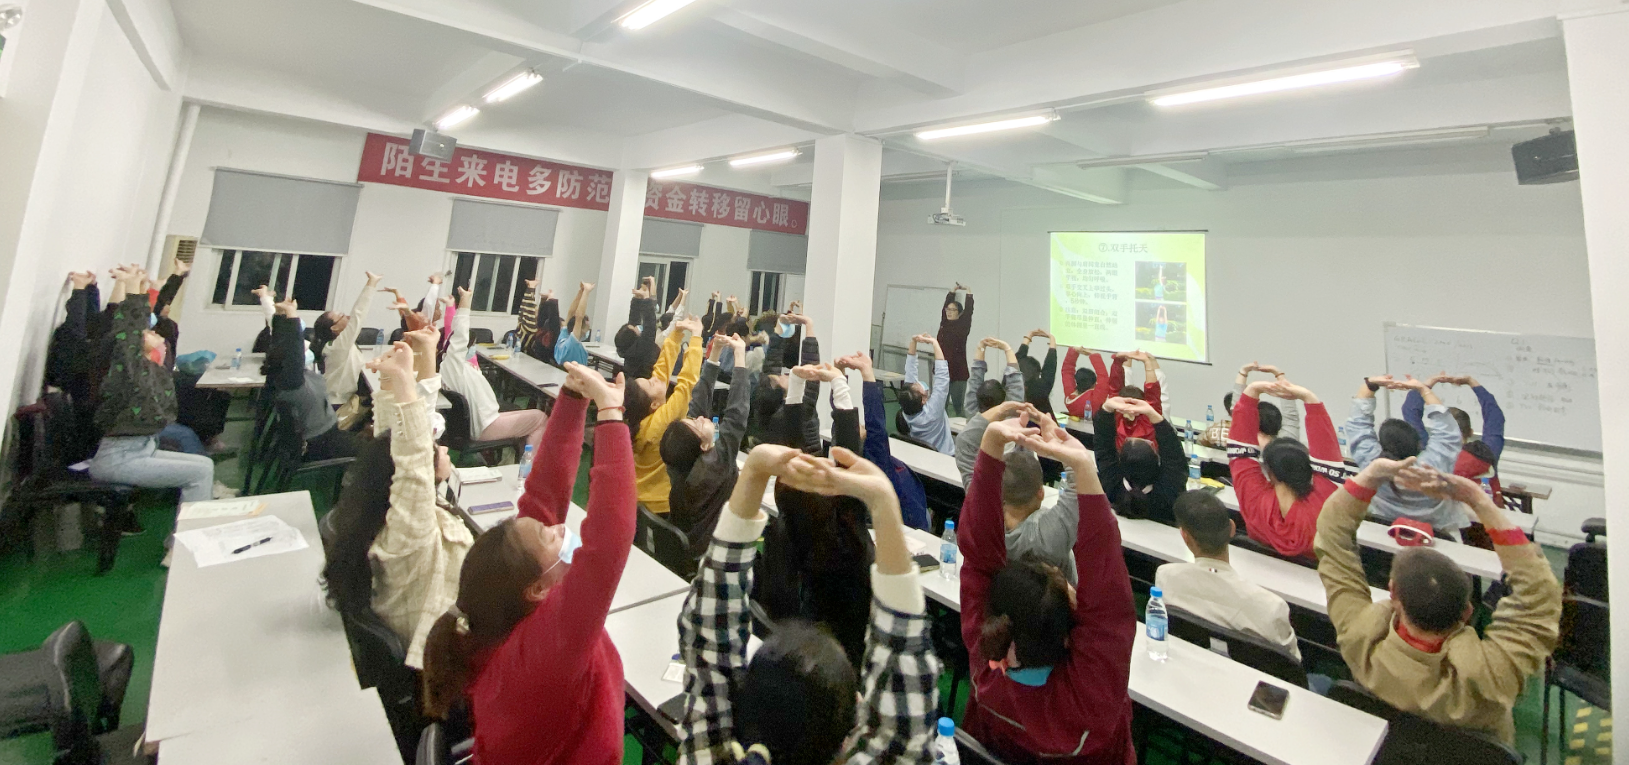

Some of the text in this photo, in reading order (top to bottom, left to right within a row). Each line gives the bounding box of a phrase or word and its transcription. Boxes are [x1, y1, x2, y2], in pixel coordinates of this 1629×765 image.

[380, 142, 612, 203] 陌生来电多防范
